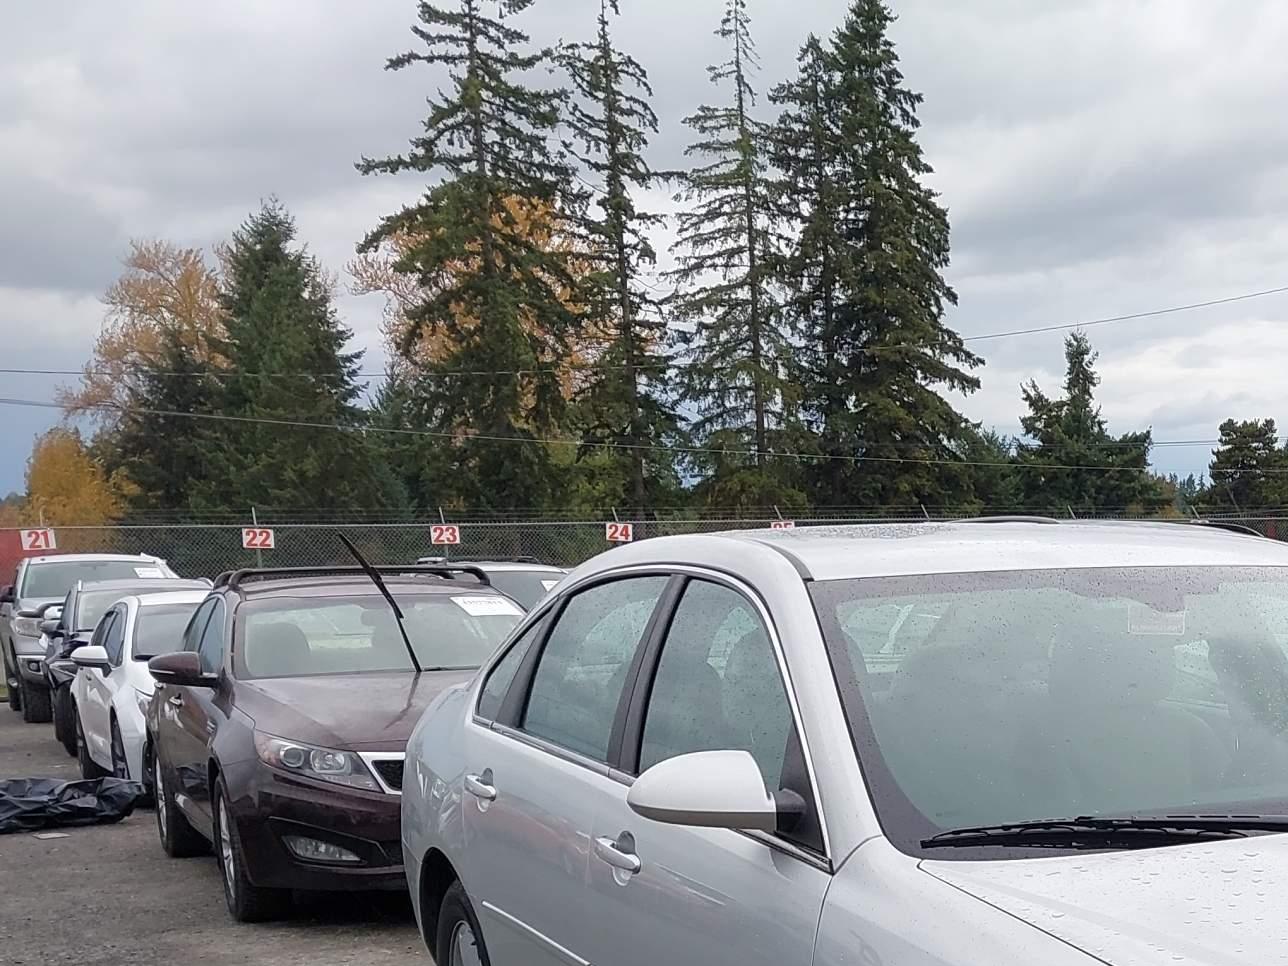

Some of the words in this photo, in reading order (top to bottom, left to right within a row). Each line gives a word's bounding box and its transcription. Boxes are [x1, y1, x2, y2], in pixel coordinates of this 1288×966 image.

[27, 531, 50, 548] 21
[245, 530, 272, 547] 22
[432, 527, 457, 544] 23
[608, 524, 630, 541] 24
